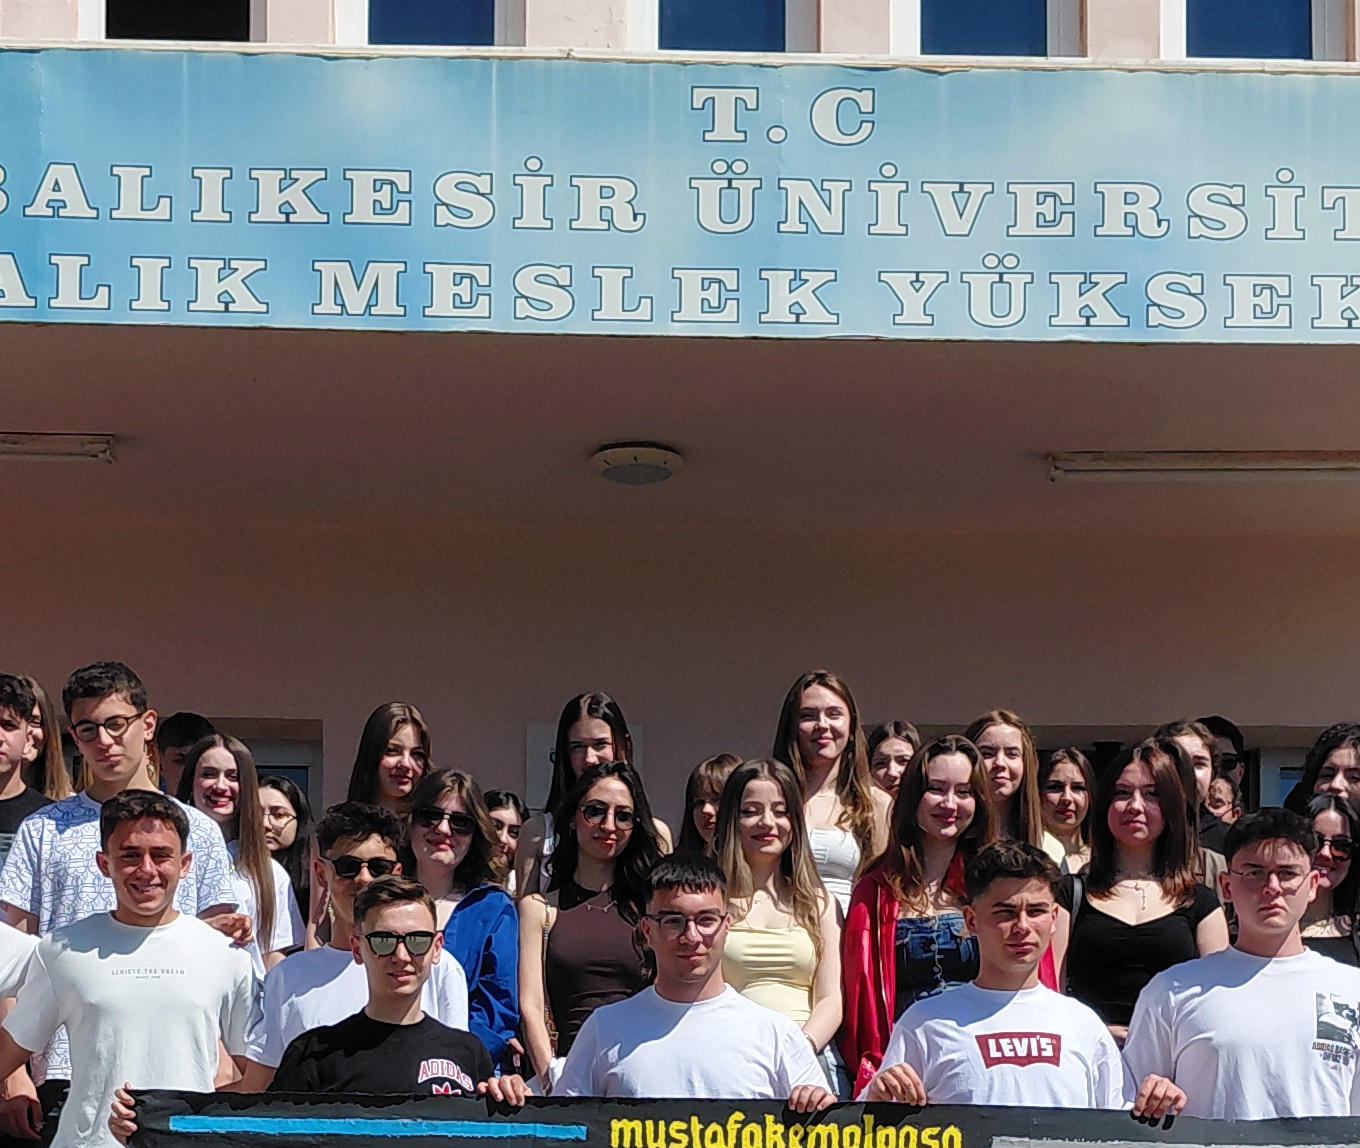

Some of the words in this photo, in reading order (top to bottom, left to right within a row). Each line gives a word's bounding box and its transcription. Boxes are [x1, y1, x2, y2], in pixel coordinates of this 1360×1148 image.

[311, 260, 840, 325] MESLEK
[111, 968, 141, 976] ACHIEVE
[987, 1034, 1054, 1058] LEVI'S
[418, 1058, 474, 1091] ADIDAS
